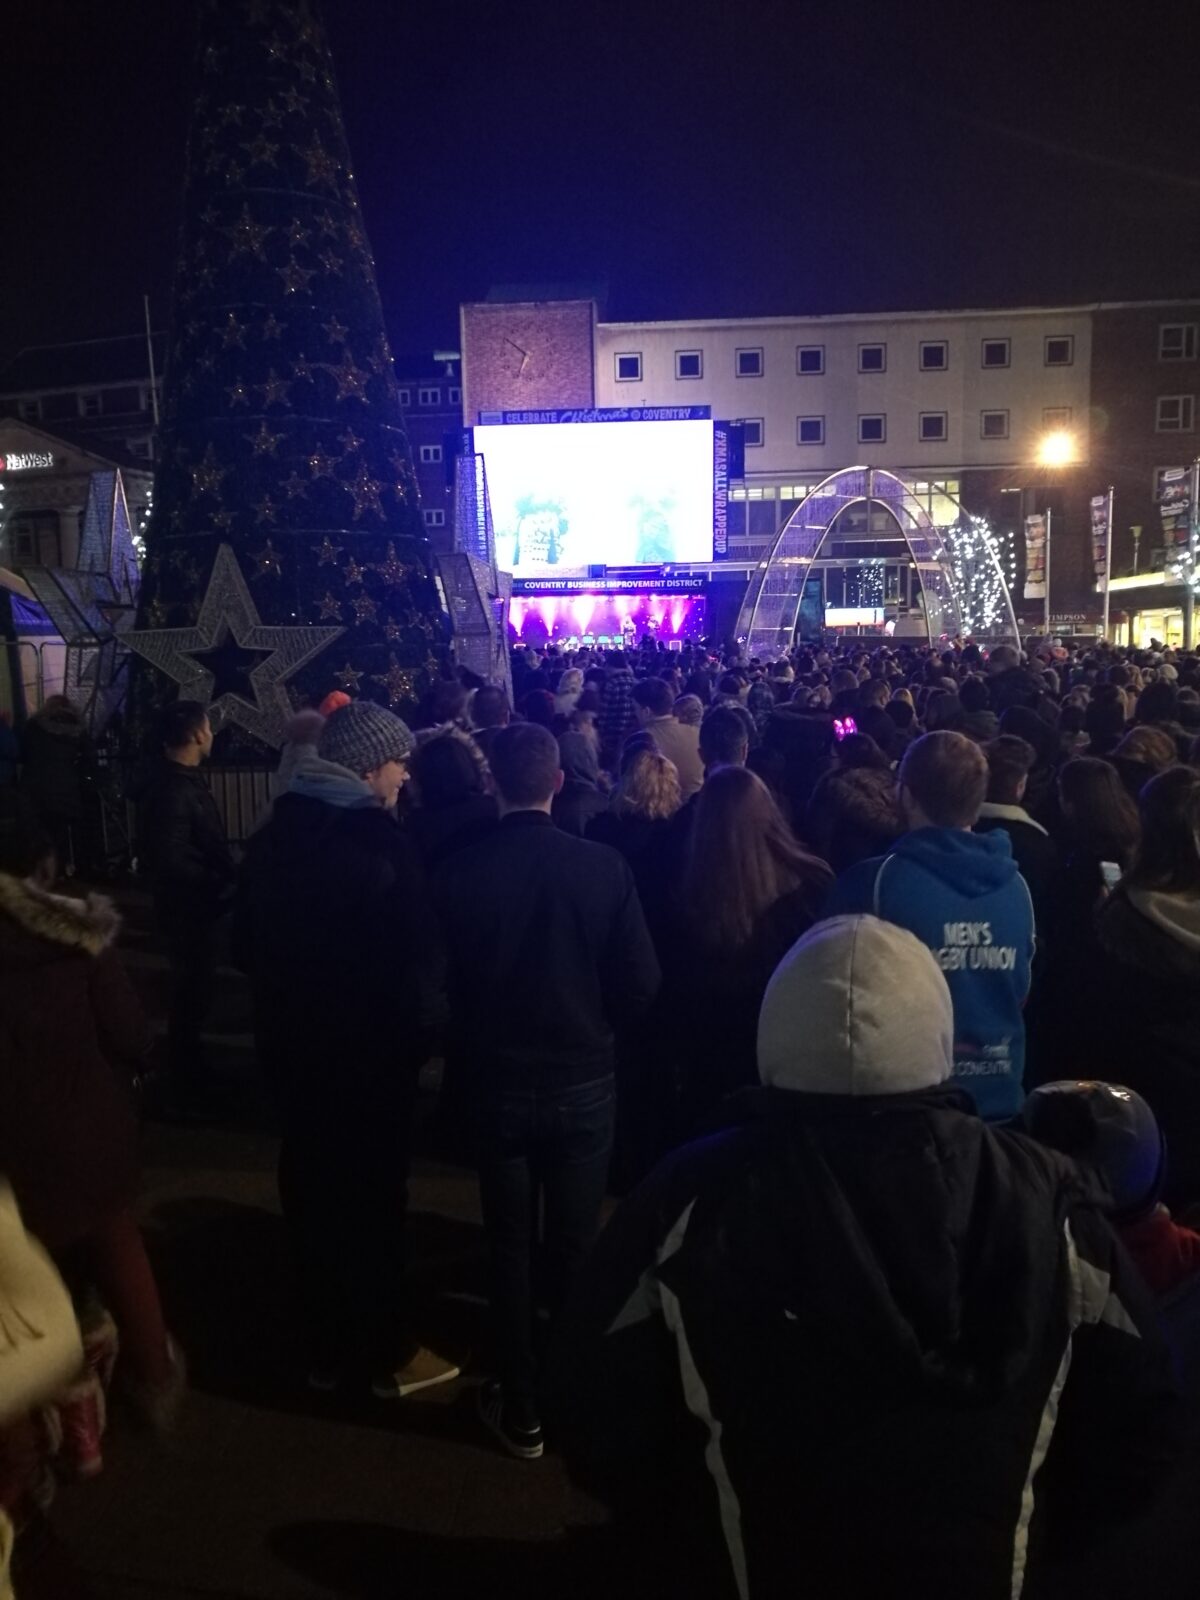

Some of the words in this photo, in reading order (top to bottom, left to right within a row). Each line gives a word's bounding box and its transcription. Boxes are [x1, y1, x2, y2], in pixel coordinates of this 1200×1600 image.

[506, 412, 558, 424] CELEBRATE
[642, 408, 691, 420] COVENTRY
[6, 452, 54, 470] NatWest
[715, 430, 727, 554] #XMASALLWRAPPEDUP
[524, 581, 566, 589] COVENTRY
[606, 580, 665, 588] IMPROVEMENT
[666, 579, 703, 587] DISTRICT
[969, 946, 1017, 970] UNION
